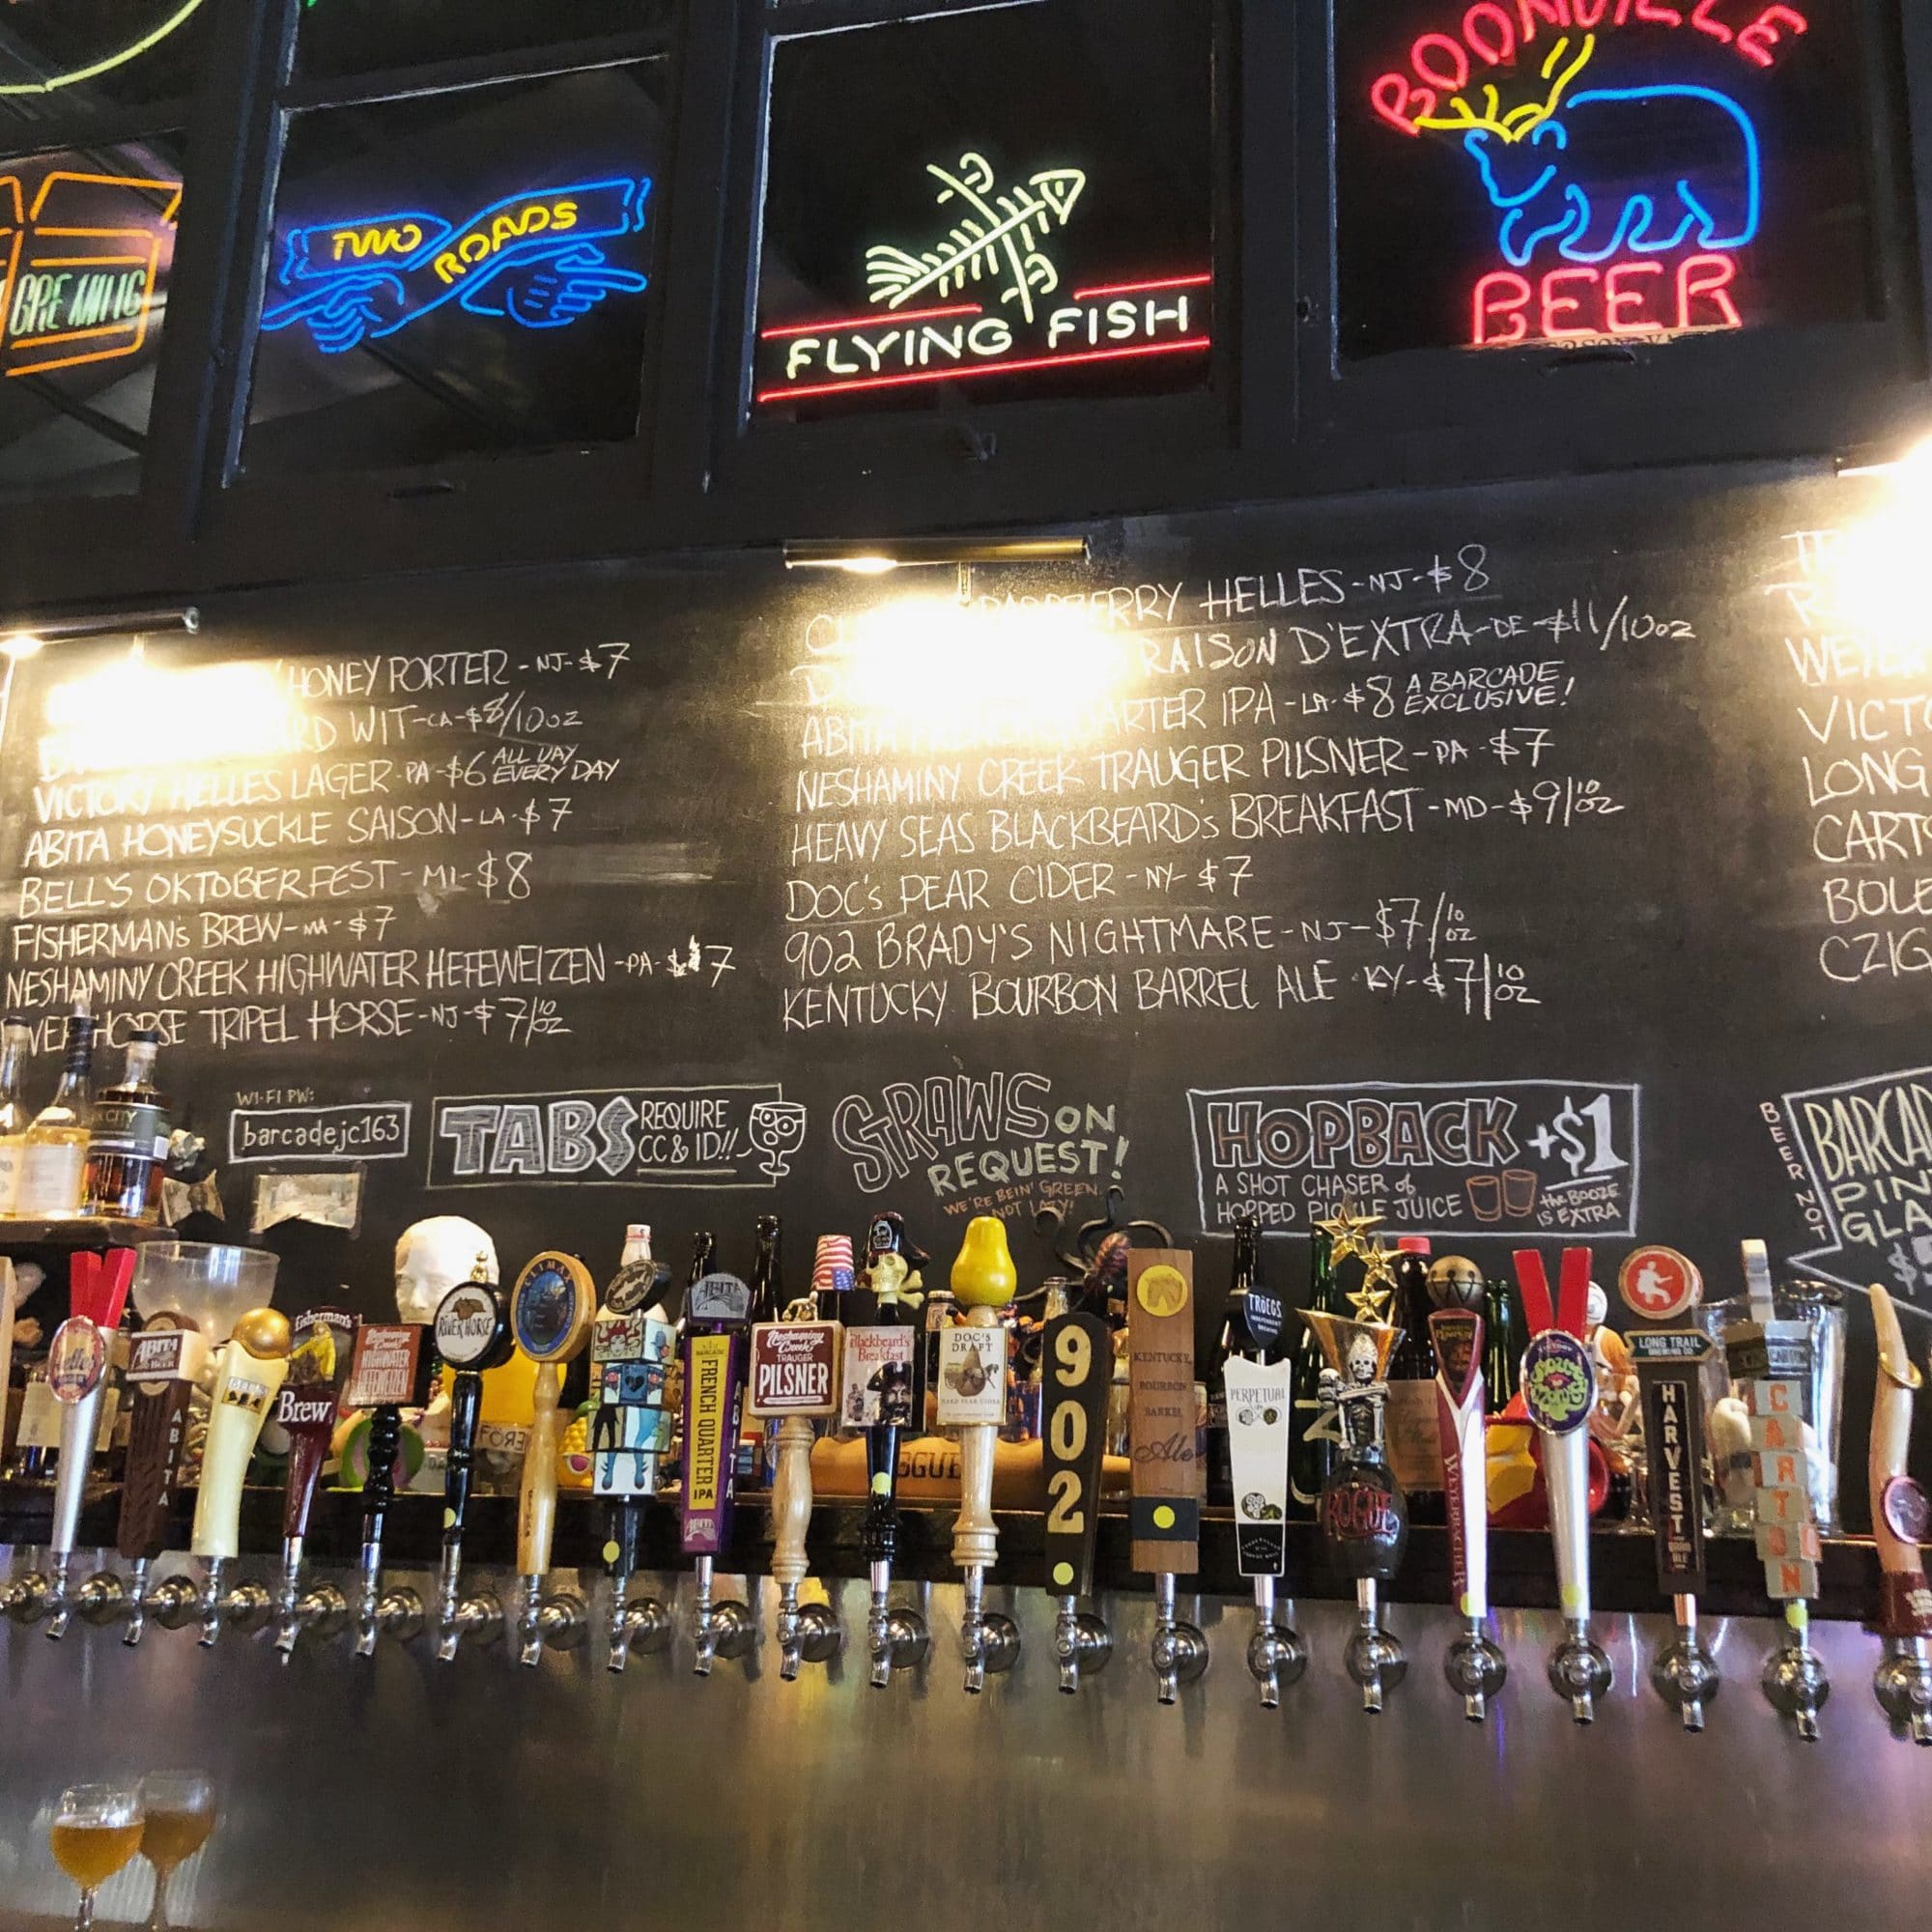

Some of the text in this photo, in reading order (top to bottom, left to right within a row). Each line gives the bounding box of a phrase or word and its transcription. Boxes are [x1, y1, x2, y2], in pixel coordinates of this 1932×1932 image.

[331, 222, 422, 261] TWO
[432, 201, 578, 285] ROADS
[1472, 253, 1743, 346] BEER
[785, 295, 1188, 380] FLYING FISH
[1199, 567, 1346, 621] HELLES
[1140, 610, 1473, 676] RAISON D'EXTRA
[289, 655, 382, 698] HONEY
[389, 649, 510, 694] PORTER
[1404, 676, 1576, 716] EXCLUSIVE!
[1406, 661, 1564, 694] A BARCADE
[351, 704, 417, 744] WIT
[1222, 681, 1276, 726] IPA
[291, 758, 392, 800] LAGER
[492, 746, 531, 765] ALL
[492, 758, 621, 785] EVERY DAY
[795, 761, 960, 812] NESHAMINY
[978, 753, 1084, 801] CREEK
[1093, 743, 1250, 793] TRAUGER
[1260, 735, 1409, 780] PILSNER
[1802, 746, 1931, 808] LONG
[23, 825, 110, 869] ABITA
[122, 810, 333, 859] HONEYSUCKLE
[348, 801, 457, 844] SAISON
[791, 817, 888, 867] HEAVY
[900, 811, 975, 859] SEAS
[1230, 787, 1424, 839] BREAKFAST
[899, 868, 990, 913] PEAR
[1009, 861, 1116, 905] CIDER
[199, 911, 284, 950] BREW
[784, 915, 1276, 981] 902 BRADY'S NIGHTMARE
[6, 942, 606, 1009] NESHAMINY CREEK HIGHWATER HEFEWEIZEN
[782, 959, 1339, 1033] KENTUCKY BOURBON BARREL ALE
[198, 1004, 300, 1051] TRIPEL
[306, 997, 417, 1041] HORSE
[242, 1114, 401, 1154] barcadejc163
[440, 1095, 638, 1176] TABS
[640, 1099, 729, 1131] REQUIRE
[832, 1071, 1115, 1194] STRAWS ON
[1207, 1097, 1520, 1170] HOPBACK
[1759, 1101, 1804, 1181] BEER
[638, 1134, 668, 1163] CC
[927, 1135, 1129, 1197] REQUEST!
[1215, 1172, 1230, 1197] A
[1236, 1171, 1293, 1197] SHOT
[1300, 1172, 1390, 1199] CHASER
[1217, 1199, 1295, 1226] HOPPED
[1393, 1193, 1463, 1220] JUICE
[1831, 1168, 1932, 1212] PIN
[1557, 1202, 1623, 1228] EXTRA
[1795, 1189, 1827, 1241] NOT
[439, 1316, 494, 1339] RIVER HORSE
[1638, 1336, 1701, 1350] LONG TRAIL
[758, 1362, 829, 1396] PILSNER
[777, 1352, 813, 1363] TRAUGER
[857, 1349, 904, 1363] Breakfast
[277, 1390, 332, 1423] Brew
[701, 1359, 719, 1414] FRENCH
[696, 1418, 717, 1485] QUARTER
[1046, 1323, 1093, 1534] 902
[157, 1407, 183, 1507] ABITA
[1662, 1383, 1684, 1533] HARVEST
[694, 1488, 714, 1500] IPA
